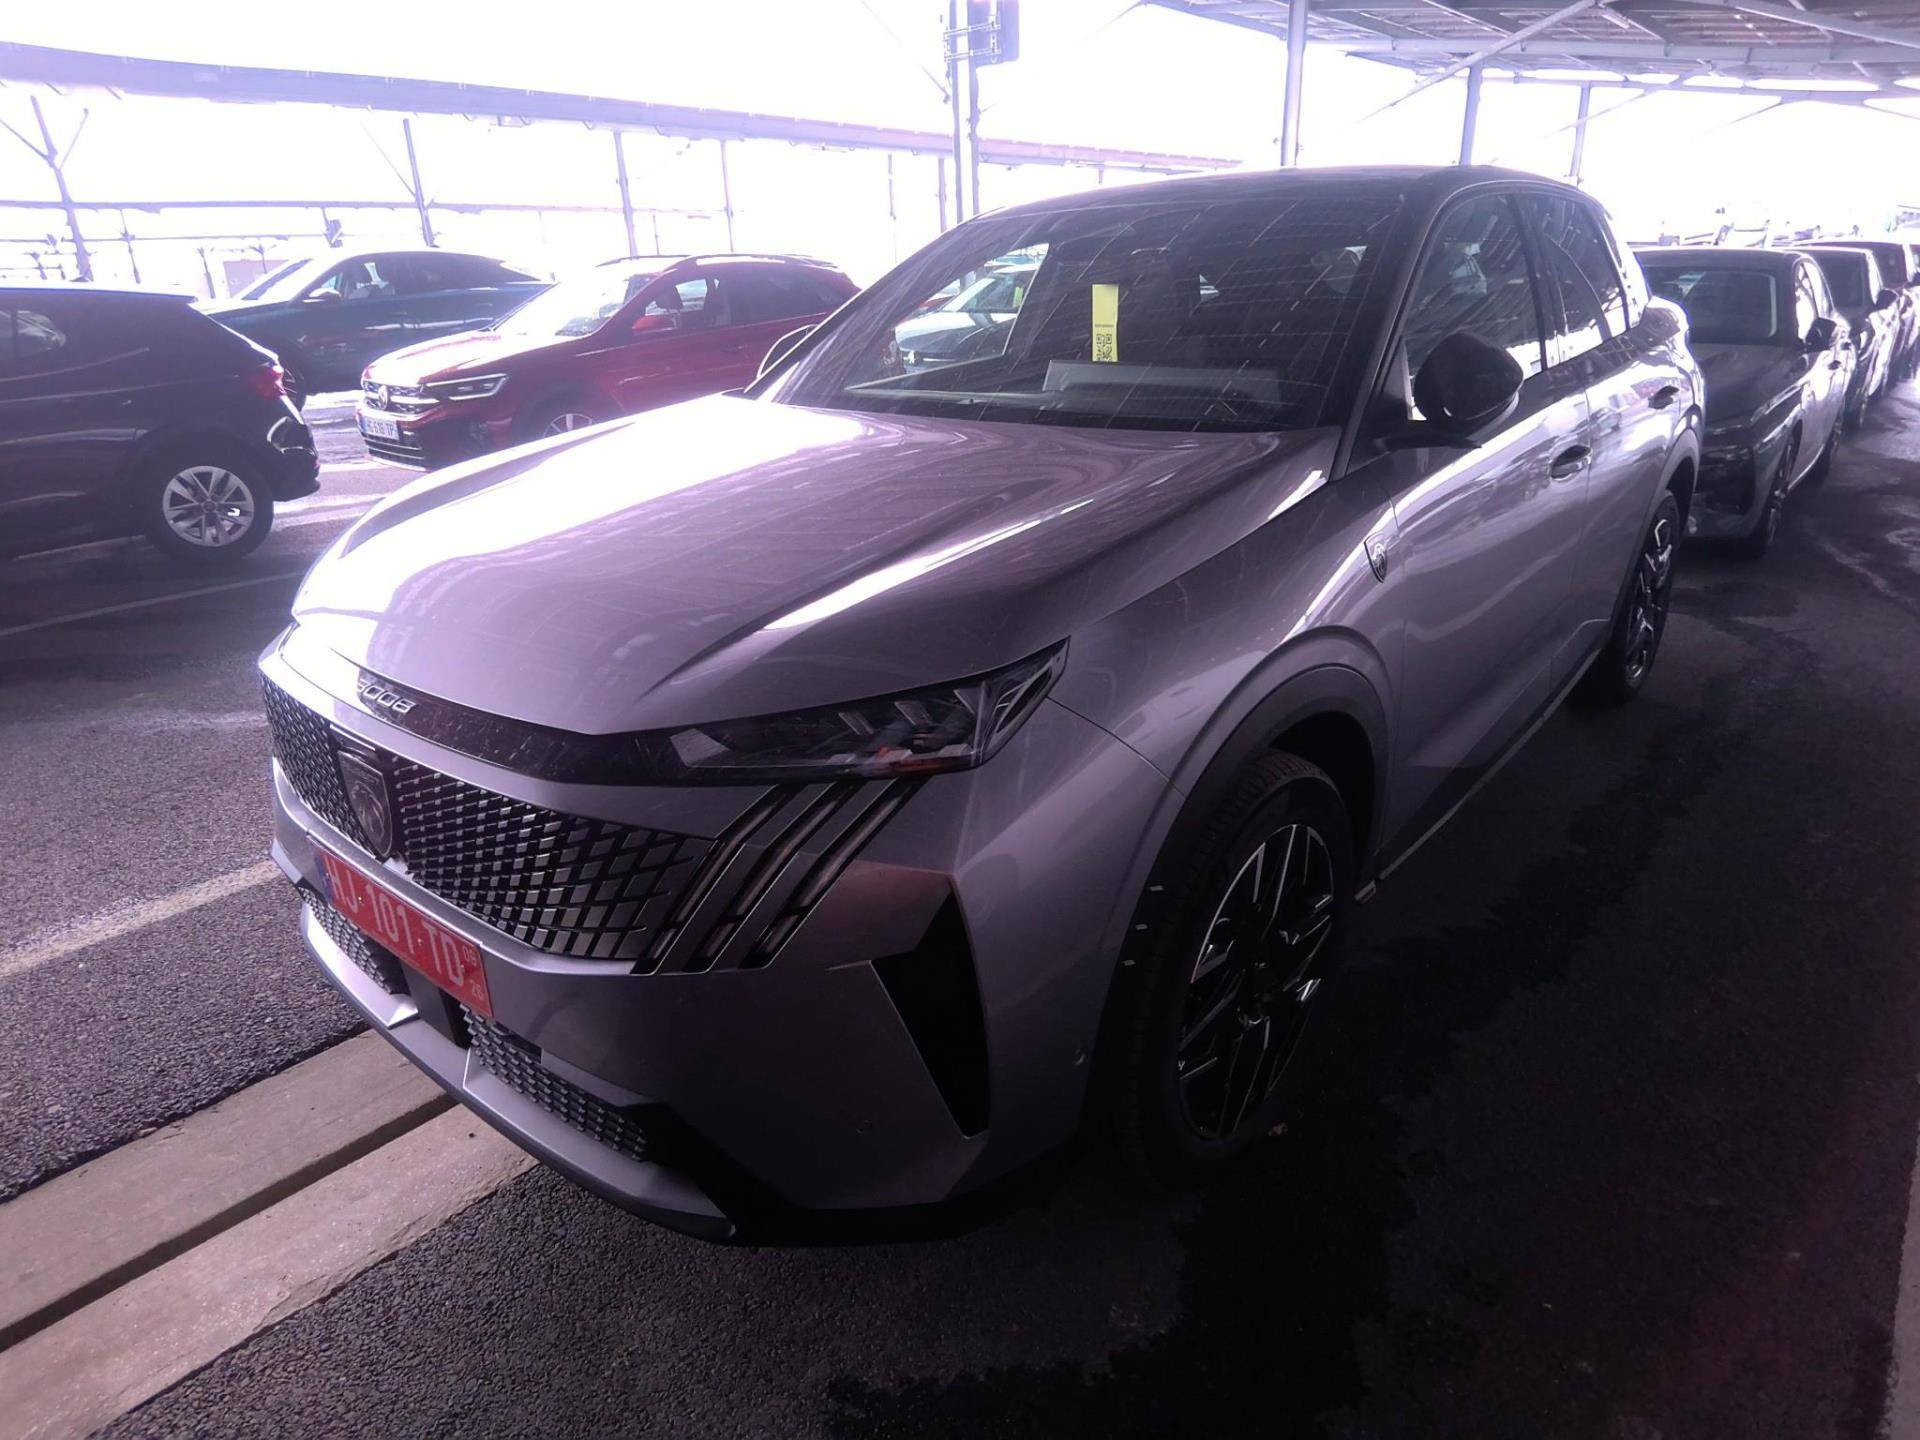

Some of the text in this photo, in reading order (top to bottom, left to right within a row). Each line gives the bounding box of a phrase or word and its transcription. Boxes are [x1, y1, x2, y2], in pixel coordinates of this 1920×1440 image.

[357, 678, 416, 713] 3008
[323, 854, 465, 987] HJ 101 TD
